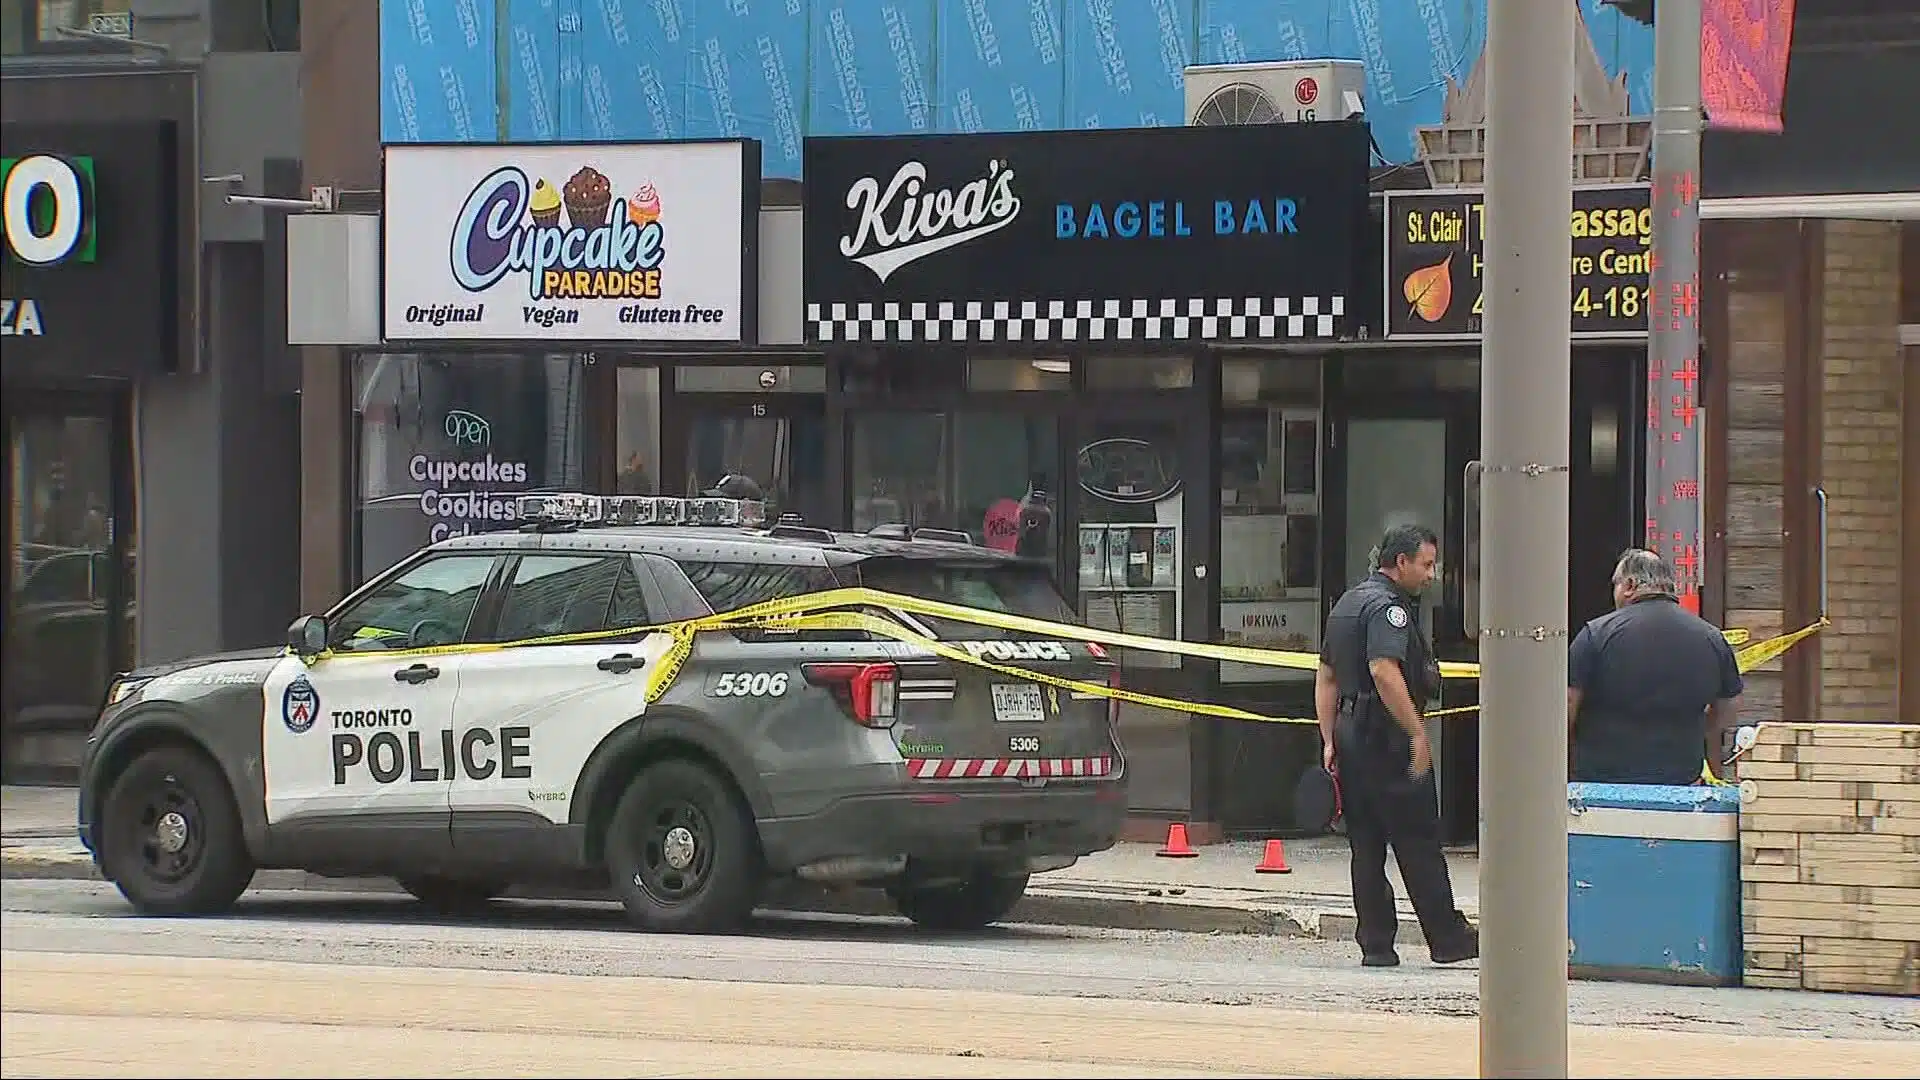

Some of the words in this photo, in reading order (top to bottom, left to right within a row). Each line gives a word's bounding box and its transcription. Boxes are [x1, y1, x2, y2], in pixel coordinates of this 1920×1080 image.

[840, 160, 1020, 262] Kiva's
[1056, 201, 1192, 240] BAGEL
[1213, 197, 1298, 234] BAR
[450, 166, 664, 300] Cupcake
[1407, 211, 1426, 243] St.
[1430, 211, 1463, 242] Clair
[544, 270, 662, 299] PARADISE
[405, 304, 484, 327] Original
[522, 306, 578, 328] Vegan
[618, 305, 681, 324] Gluten
[683, 305, 723, 327] free
[583, 353, 596, 366] 15
[752, 404, 766, 417] 15
[445, 412, 491, 447] open
[409, 453, 527, 489] Cupcakes
[420, 489, 516, 521] Cookies
[1254, 613, 1287, 628] KIVA'S
[961, 641, 1072, 661] POLICE
[715, 671, 789, 698] 5306
[331, 708, 412, 729] TORONTO
[332, 726, 532, 785] POLICE
[1009, 736, 1039, 752] 5306
